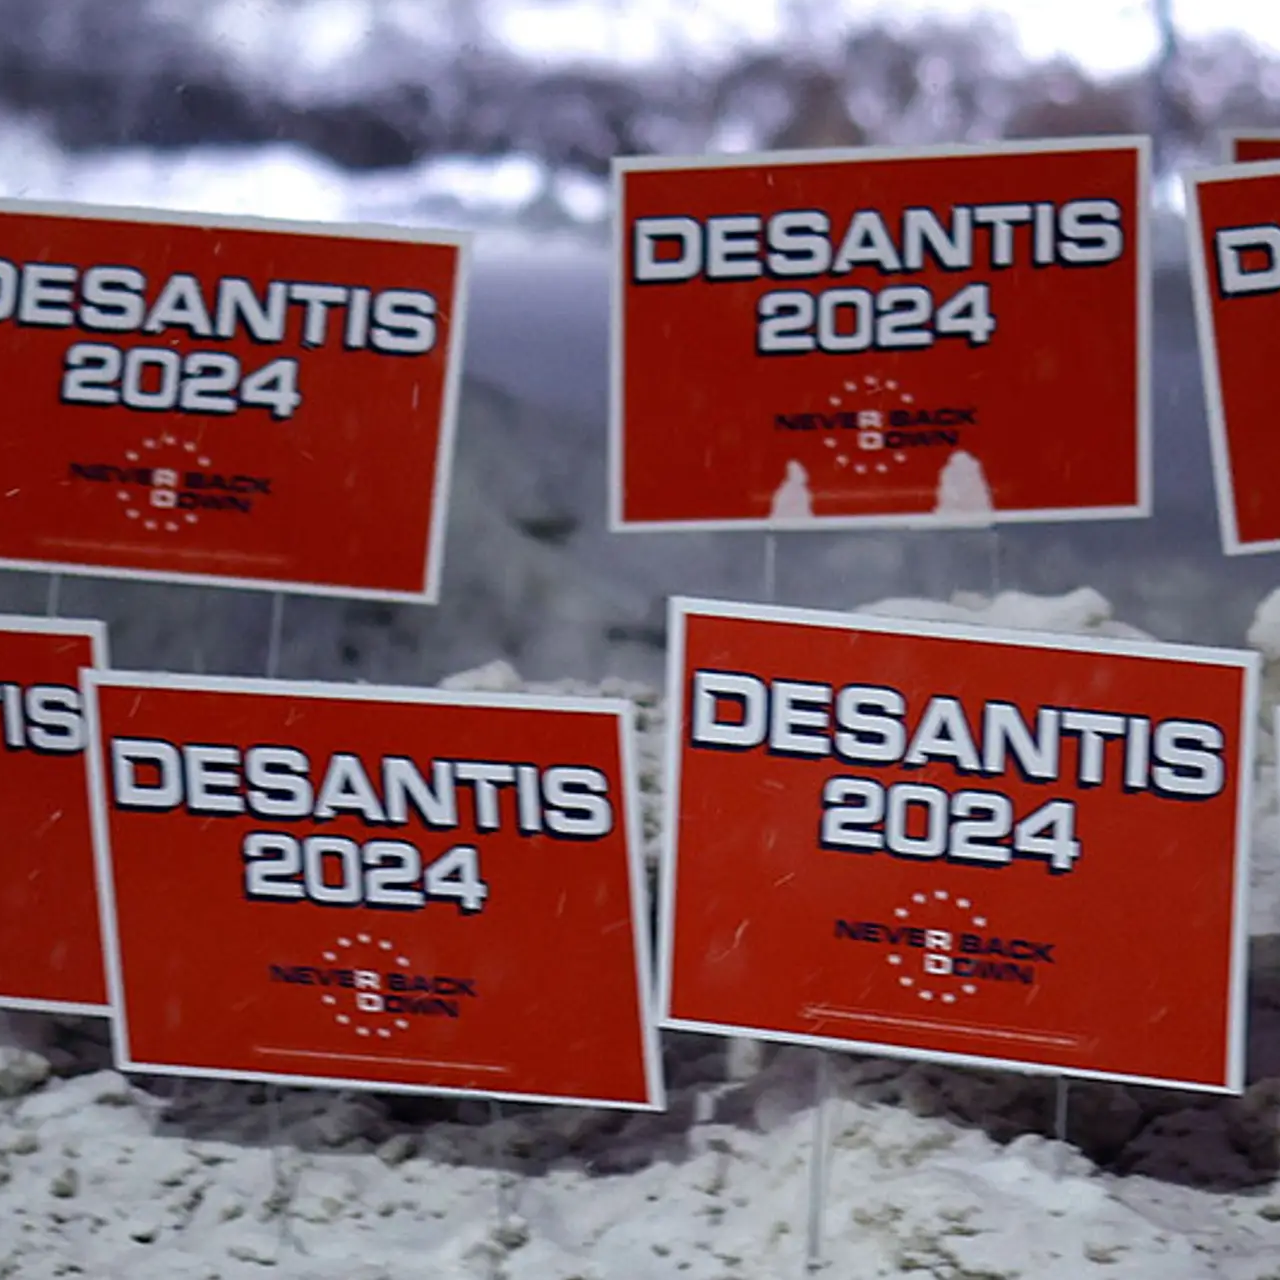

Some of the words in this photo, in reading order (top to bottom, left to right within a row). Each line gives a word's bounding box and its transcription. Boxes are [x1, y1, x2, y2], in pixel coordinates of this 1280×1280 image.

[634, 199, 1123, 281] DESANTIS
[758, 283, 996, 352] 2024
[62, 342, 302, 418] 2024
[889, 406, 977, 427] BACK
[185, 472, 271, 493] BACK
[692, 670, 1224, 796] DESANTIS
[111, 738, 613, 836] DESANTIS
[821, 777, 1081, 870] 2024
[243, 832, 488, 911] 2024
[386, 972, 477, 997] BACK
[959, 932, 1055, 963] BACK
